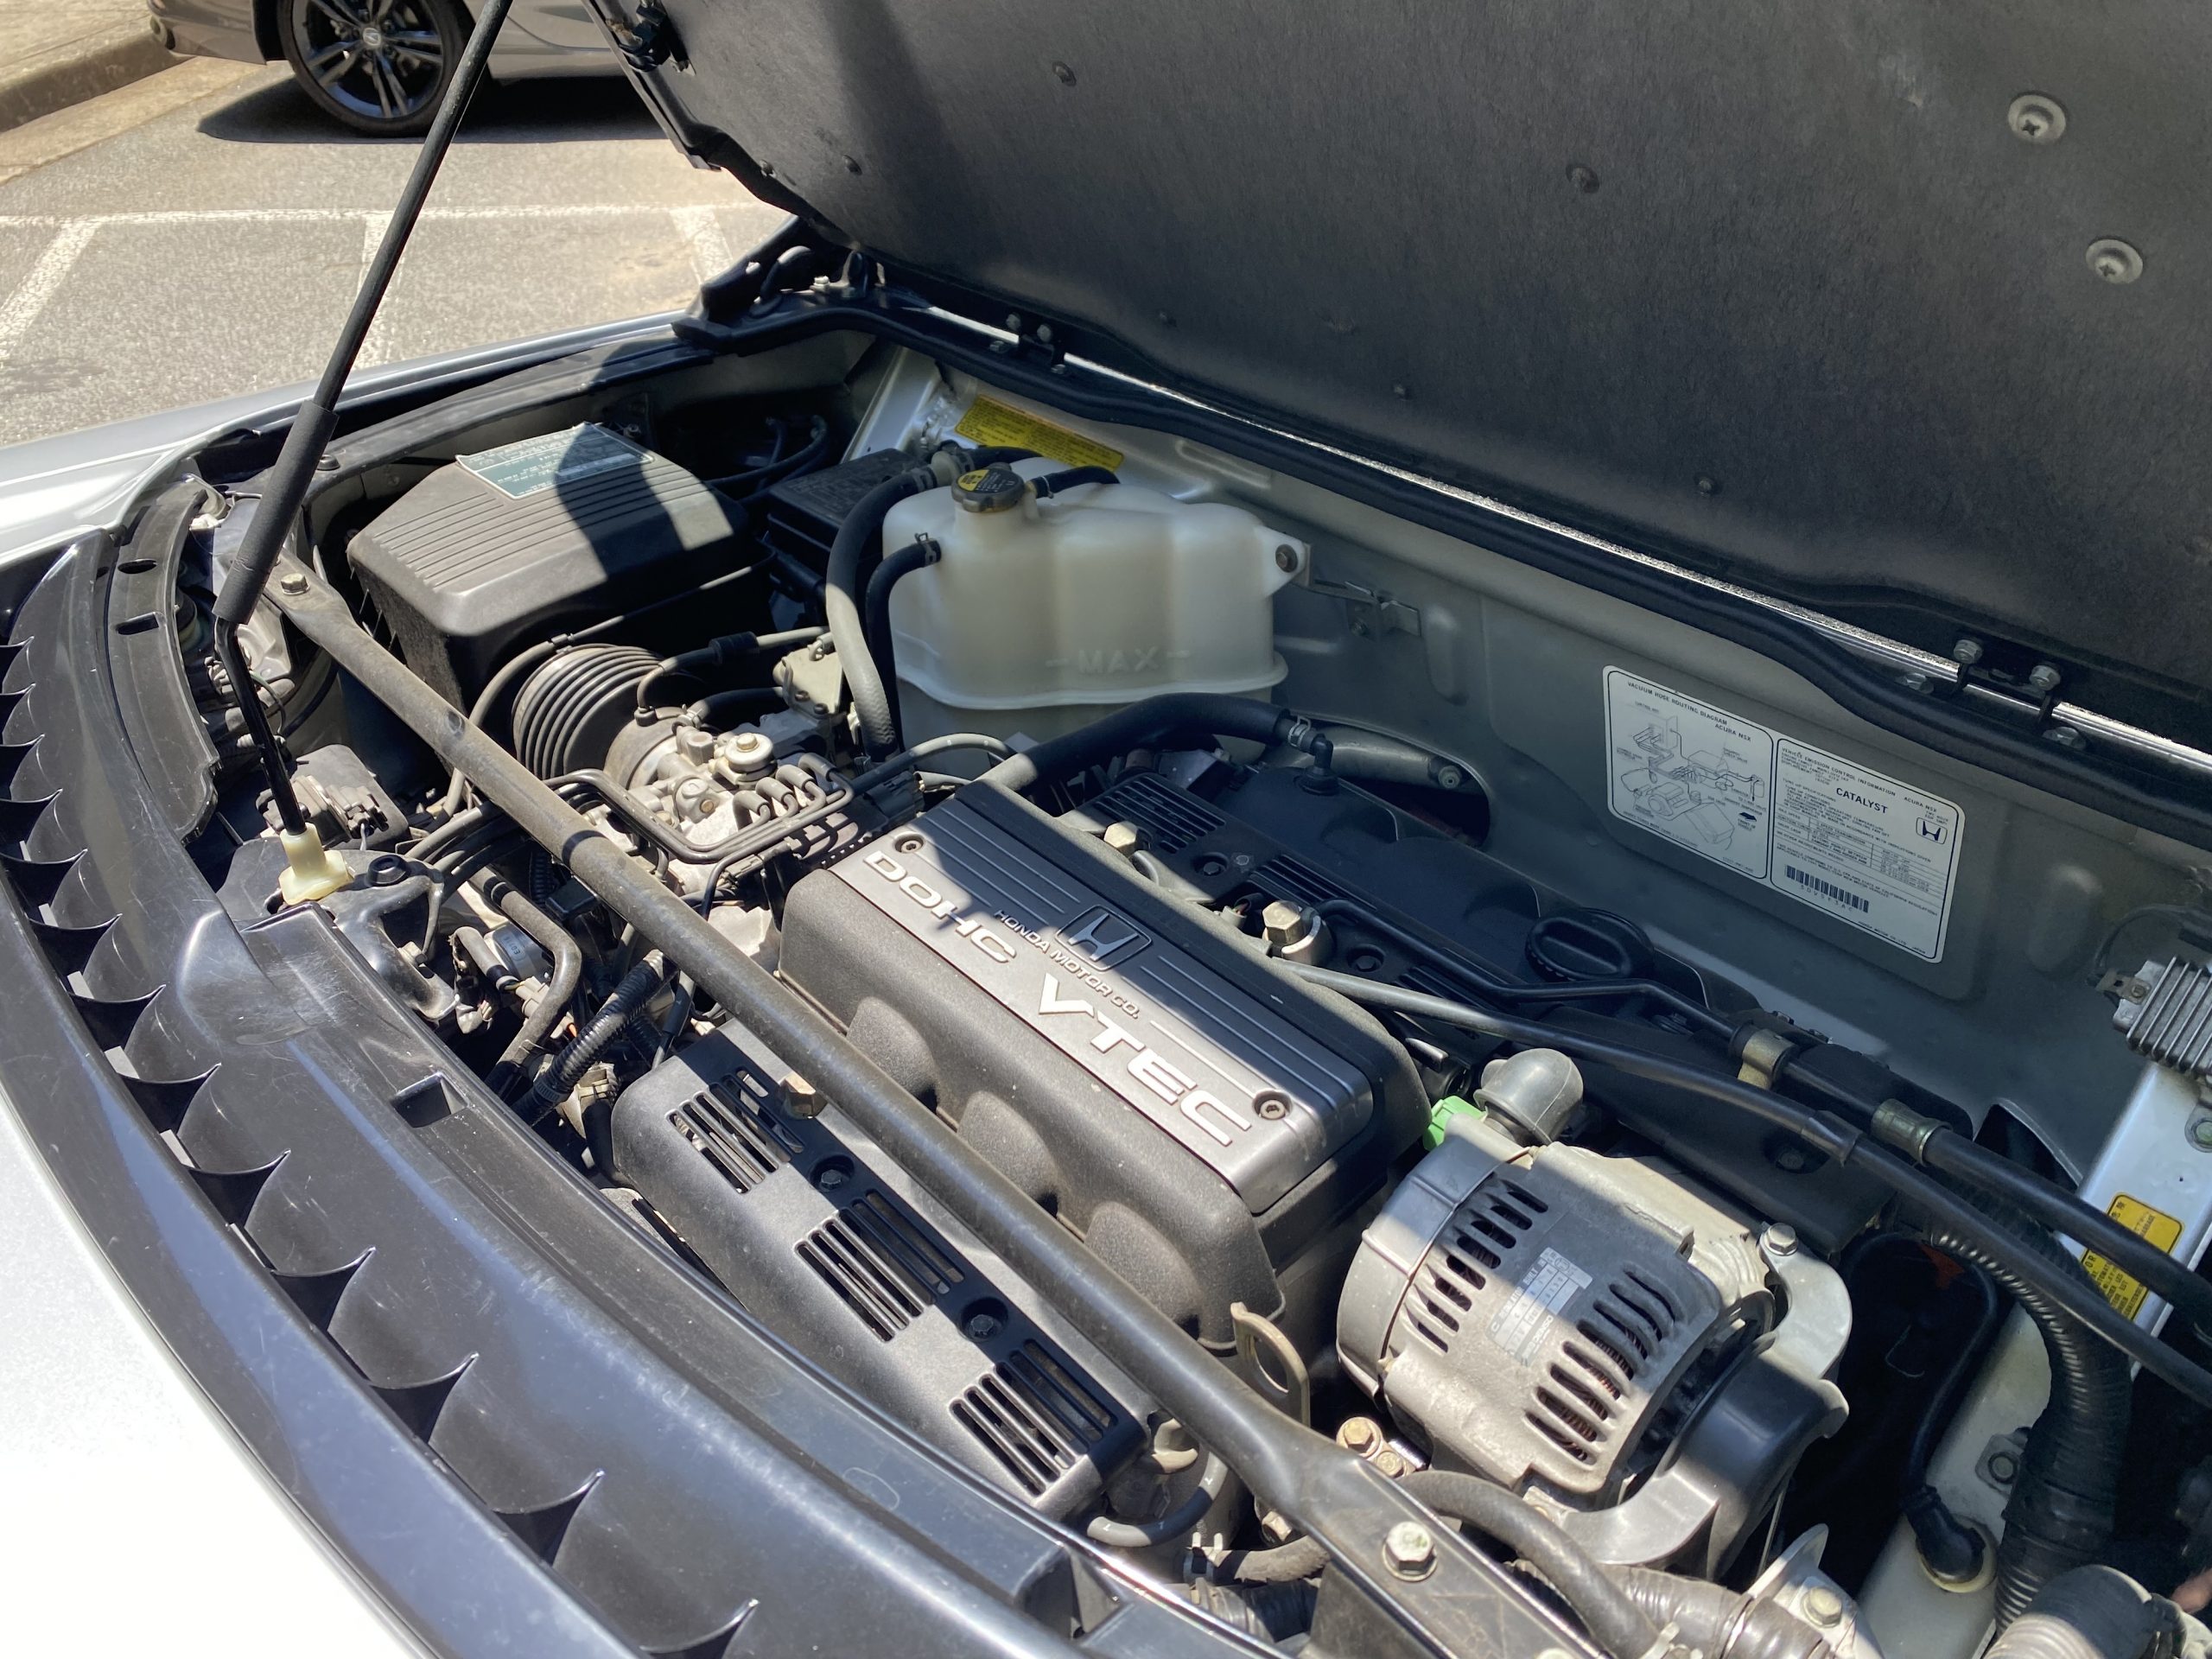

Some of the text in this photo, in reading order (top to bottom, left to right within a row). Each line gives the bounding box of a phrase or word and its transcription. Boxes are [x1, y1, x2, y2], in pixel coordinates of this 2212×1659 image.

[1079, 646, 1160, 673] MAX
[1627, 680, 1726, 725] VACUUM HOSE ROUTING DIAGRAM
[1715, 722, 1751, 741] ACURA NSX
[1782, 747, 1802, 759] VEHICLE
[1804, 756, 1829, 770] EMISSION
[1831, 766, 1854, 779] CONTROL
[1858, 778, 1896, 797] INFORMATION
[1904, 796, 1923, 807] ACURA
[1836, 787, 1888, 814] CATALYST
[863, 851, 1016, 963] DOHC
[994, 909, 1141, 1020] HONDA MOTOR CO.
[1038, 972, 1252, 1147] VTEC
